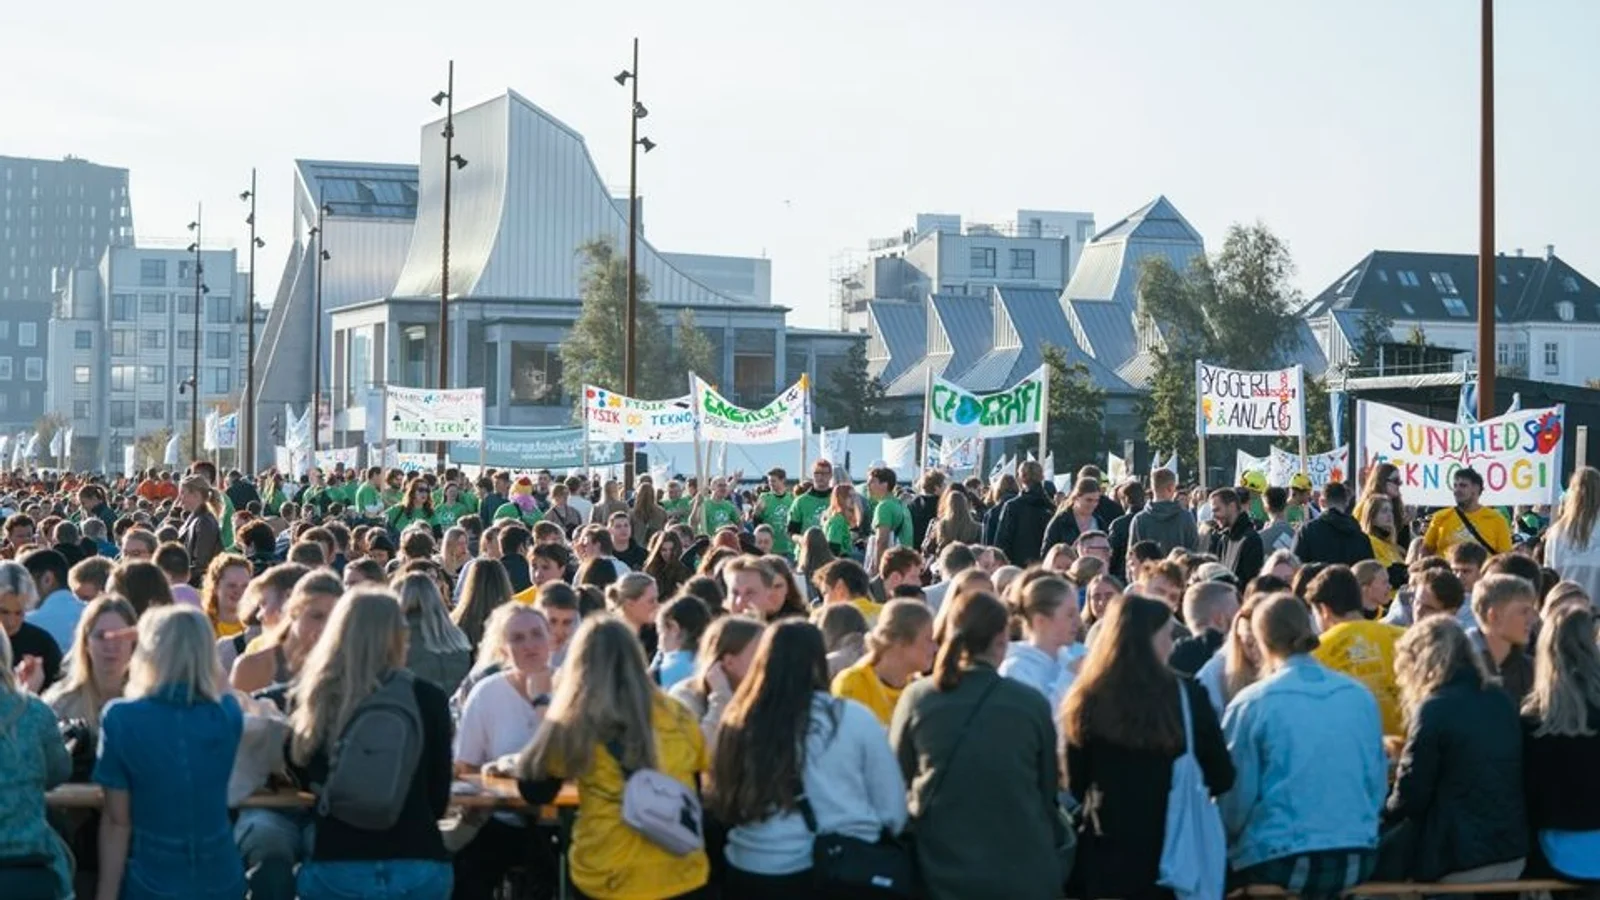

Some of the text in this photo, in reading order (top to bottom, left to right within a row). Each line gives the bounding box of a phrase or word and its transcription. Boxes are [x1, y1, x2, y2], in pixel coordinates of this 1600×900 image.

[1201, 366, 1270, 398] BYGGERI
[585, 407, 621, 425] FYSIK
[704, 389, 788, 423] ENERGI
[1391, 420, 1540, 455] SUNDHEDS
